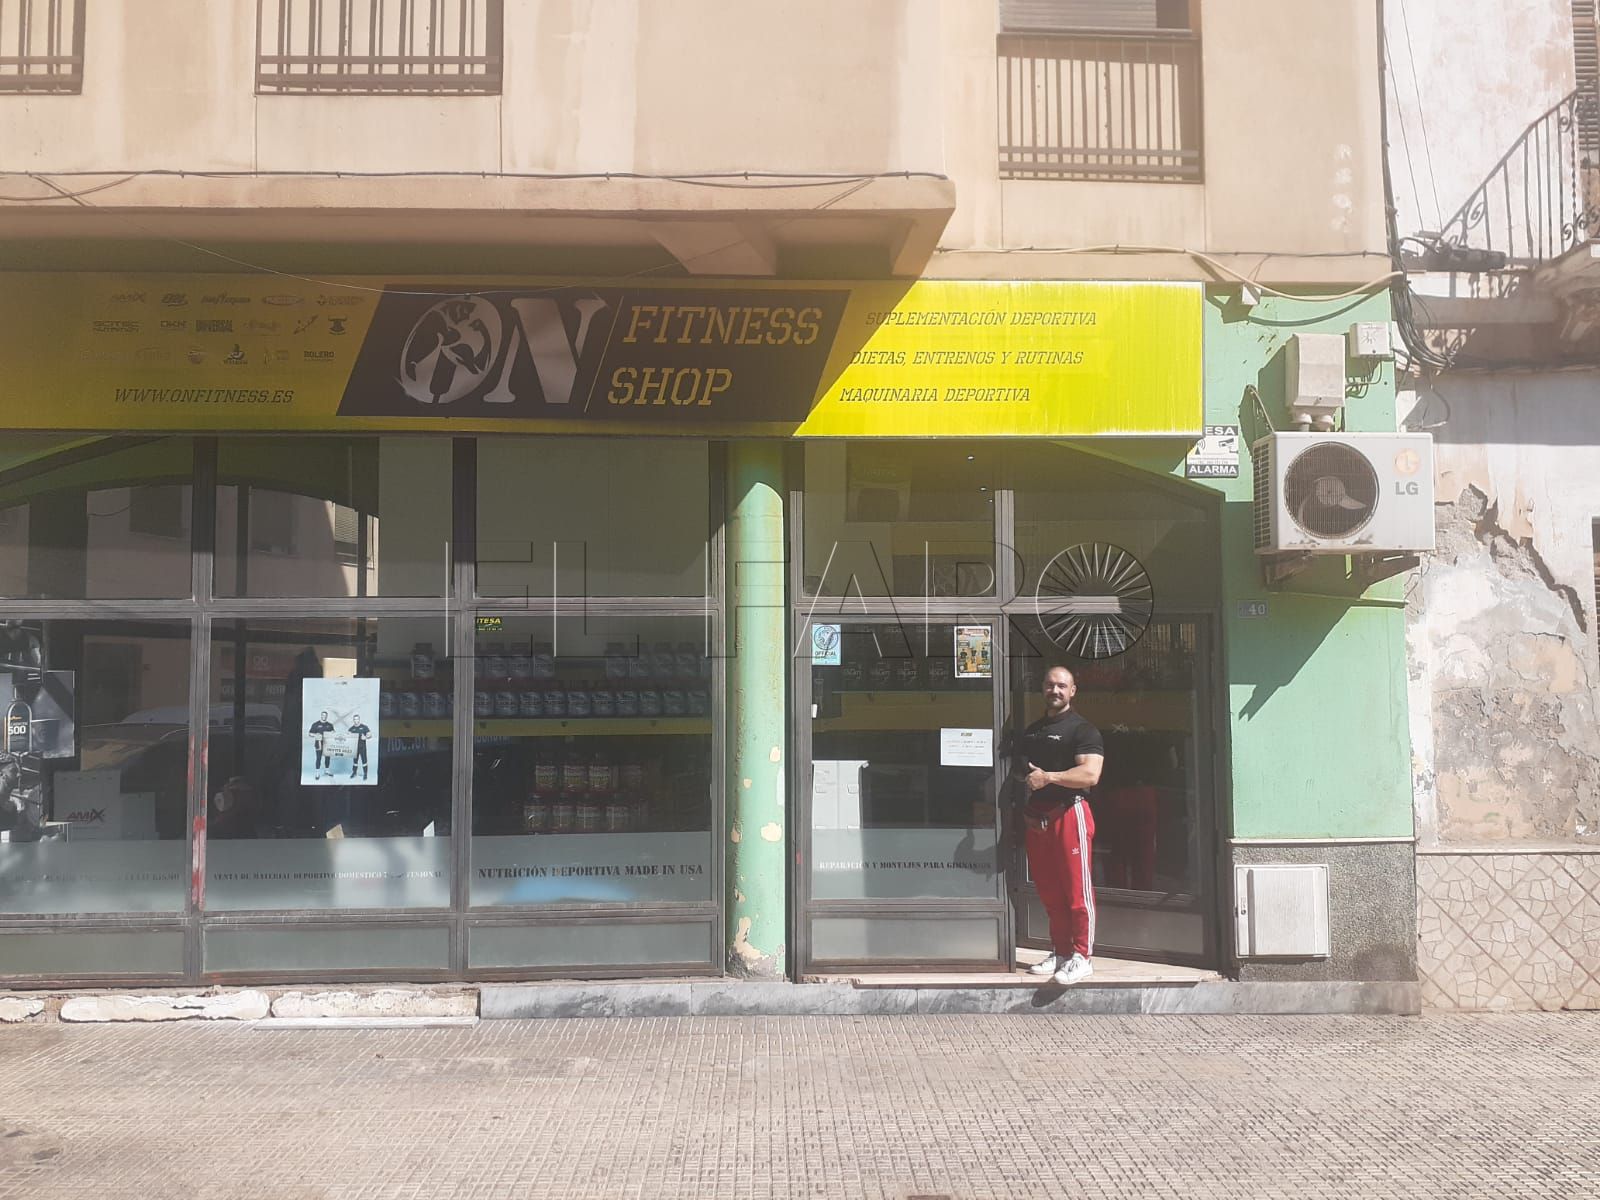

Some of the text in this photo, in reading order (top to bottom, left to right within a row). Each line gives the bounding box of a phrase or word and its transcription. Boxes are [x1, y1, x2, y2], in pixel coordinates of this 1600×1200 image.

[623, 305, 823, 345] FITNESS
[866, 308, 1097, 326] SUPLEMENTACIÓN DEPORTIVA
[851, 351, 1084, 367] DIETAS, ENTRENOS Y RUTINAS
[608, 367, 733, 406] SHOP
[114, 388, 294, 404] WWW.ONFITNESS.ES
[839, 387, 1031, 403] MAQUINARIA DEPORTIVA
[1189, 465, 1237, 474] ALARMA
[1395, 482, 1419, 495] LG
[1248, 604, 1266, 616] 40
[478, 863, 704, 878] NUTRICIÓN DEPORTIVA MADE IN USA
